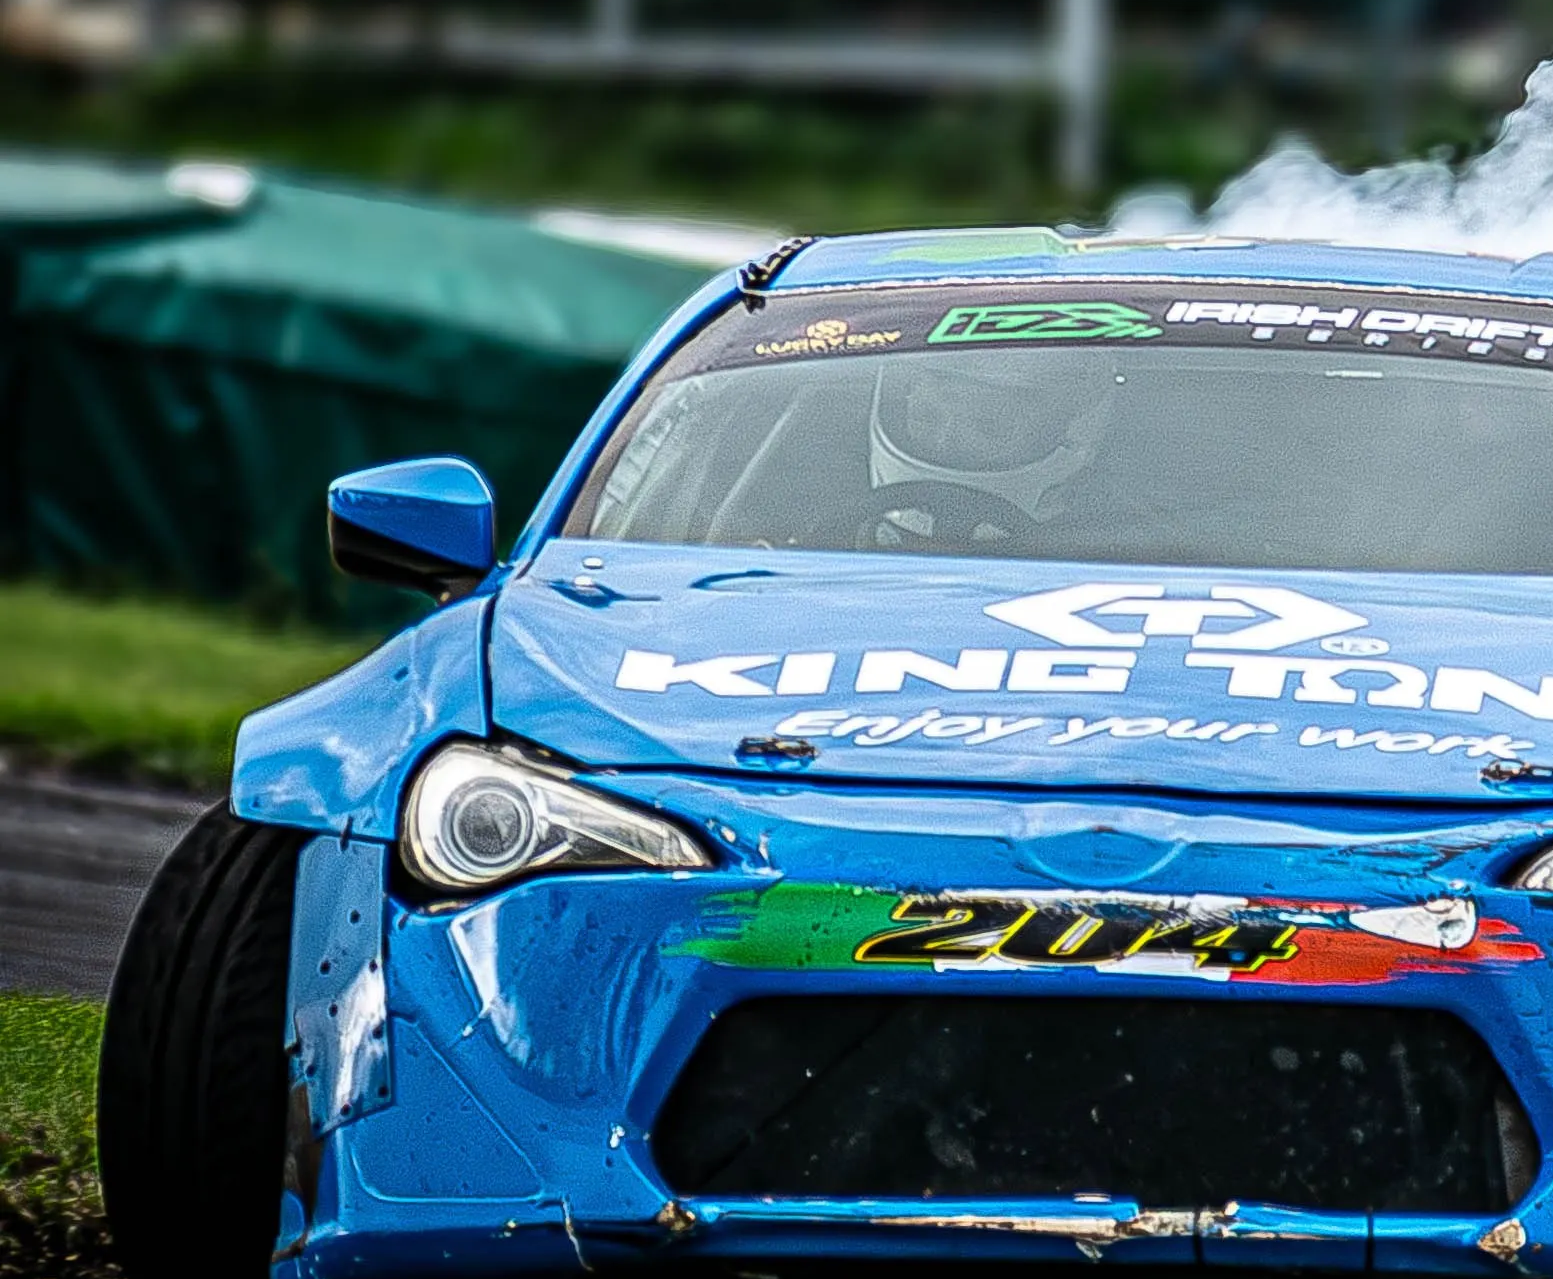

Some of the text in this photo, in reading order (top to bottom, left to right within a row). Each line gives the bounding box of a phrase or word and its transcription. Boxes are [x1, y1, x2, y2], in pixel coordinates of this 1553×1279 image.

[1165, 301, 1359, 329] IRISH
[615, 649, 1138, 697] KING
[774, 708, 1538, 759] Enjoy your work
[853, 893, 1299, 973] 204
